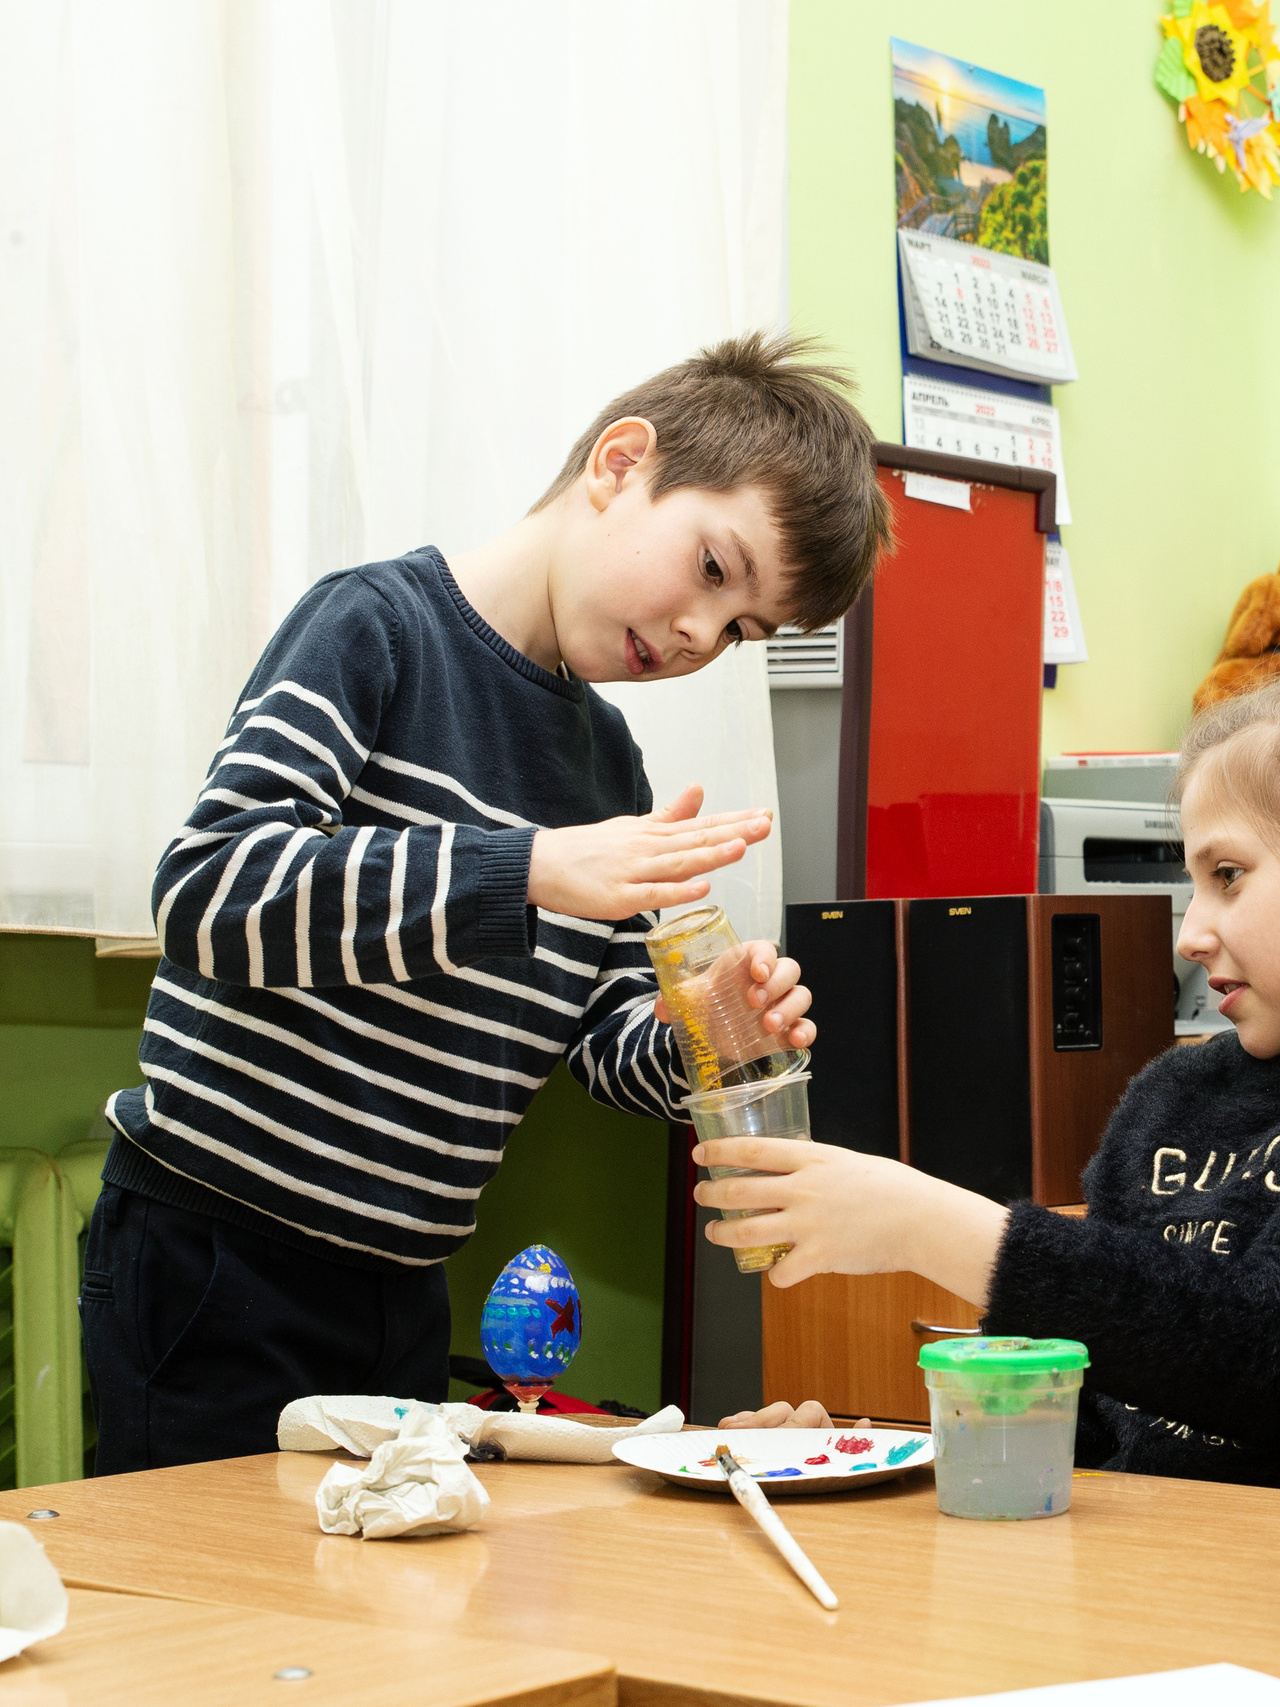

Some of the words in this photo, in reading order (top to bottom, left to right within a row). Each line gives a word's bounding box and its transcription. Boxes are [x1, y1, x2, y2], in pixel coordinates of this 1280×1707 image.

[935, 296, 947, 309] 14
[954, 302, 967, 314] 15
[973, 307, 985, 319] 16
[990, 312, 1000, 325] 17
[1007, 317, 1019, 330] 18
[1025, 322, 1037, 335] 19
[1043, 326, 1056, 339] 20
[987, 297, 999, 309] 10
[1005, 302, 1016, 315] 11
[1022, 307, 1034, 320] 12
[1040, 312, 1053, 325] 13
[938, 311, 950, 324] 21
[957, 316, 969, 329] 22
[976, 321, 988, 334] 23
[992, 327, 1004, 339] 24
[1010, 332, 1021, 345] 25
[1028, 337, 1040, 350] 26
[1046, 343, 1058, 354] 27
[942, 326, 954, 340] 28
[960, 331, 972, 345] 29
[979, 337, 990, 350] 30
[996, 342, 1007, 355] 31
[912, 392, 949, 407] АПРЕЛЬ
[975, 404, 996, 418] 2022
[936, 437, 943, 449] 4
[956, 440, 962, 453] 5
[974, 443, 981, 456] 6
[993, 447, 1000, 459] 7
[1011, 450, 1017, 463] 8
[1029, 453, 1035, 466] 9
[1041, 457, 1053, 470] 10
[1028, 438, 1034, 451] 2
[1046, 442, 1052, 455] 3
[1049, 596, 1063, 607] 15
[1052, 610, 1066, 622] 22
[1053, 625, 1069, 637] 29
[822, 911, 844, 920] SVEN
[949, 907, 972, 916] SVEN
